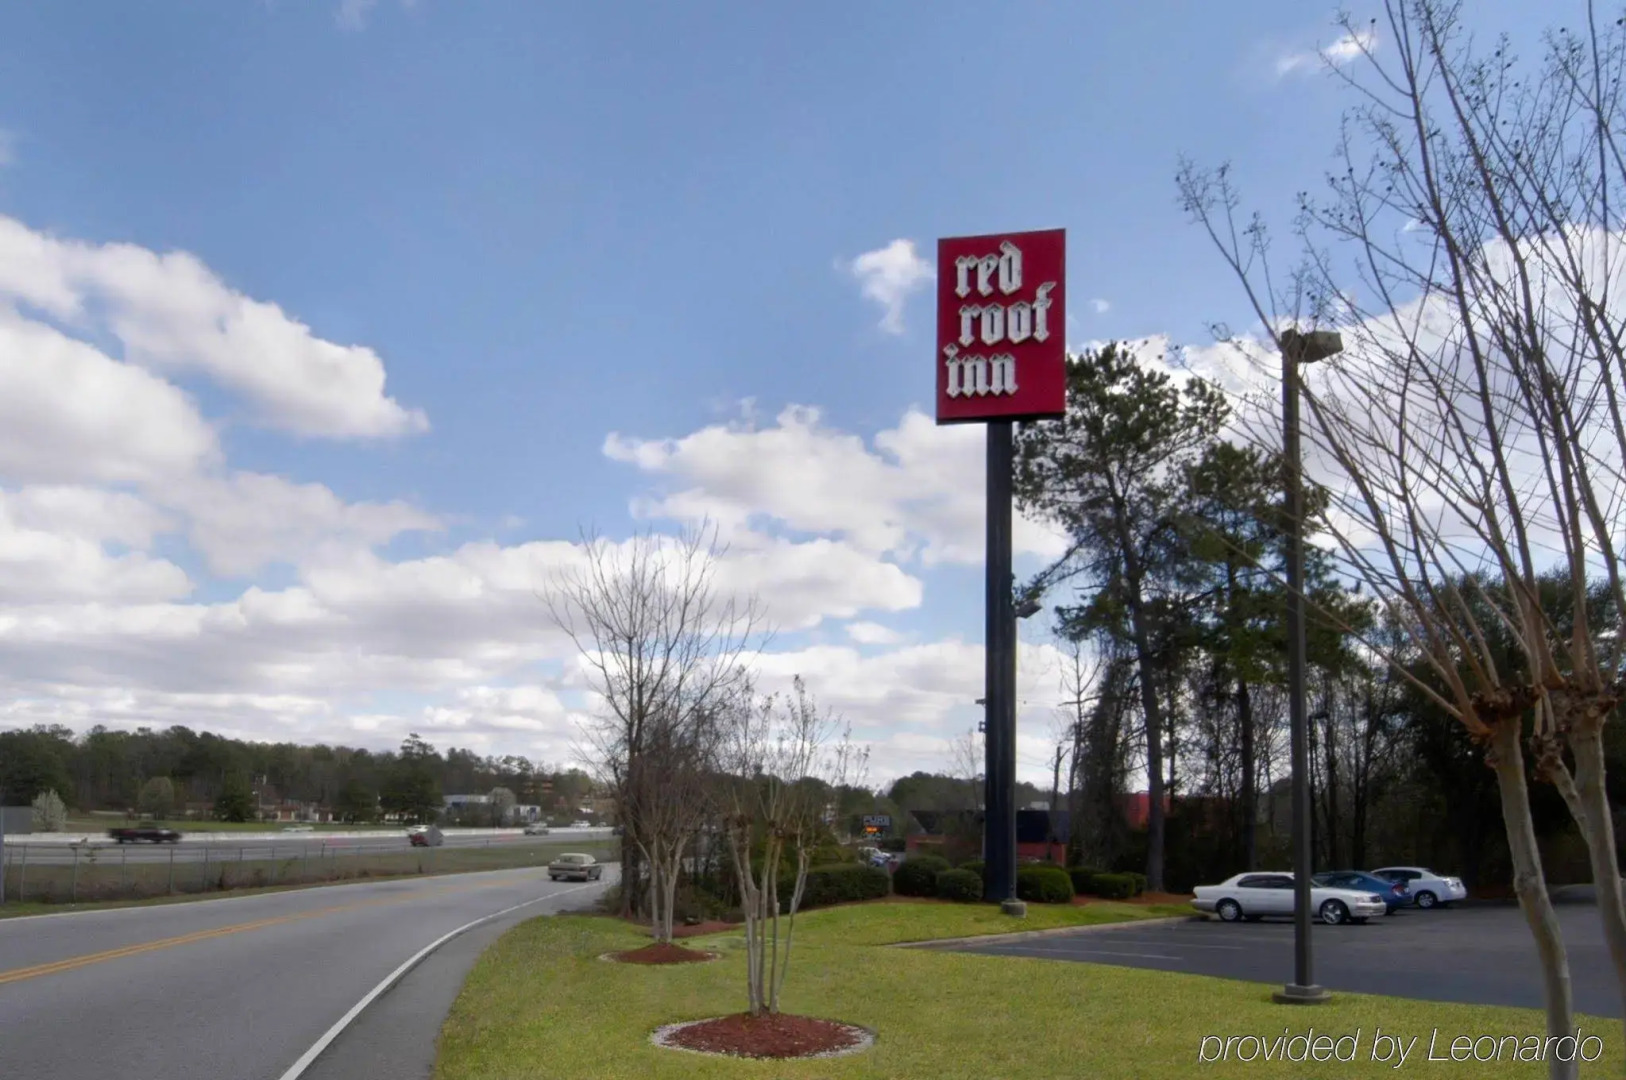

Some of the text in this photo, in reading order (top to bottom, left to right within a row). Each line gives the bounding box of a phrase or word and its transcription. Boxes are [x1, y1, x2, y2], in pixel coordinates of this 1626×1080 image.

[955, 240, 1022, 298] red
[959, 281, 1057, 347] roof
[944, 343, 1018, 398] inn
